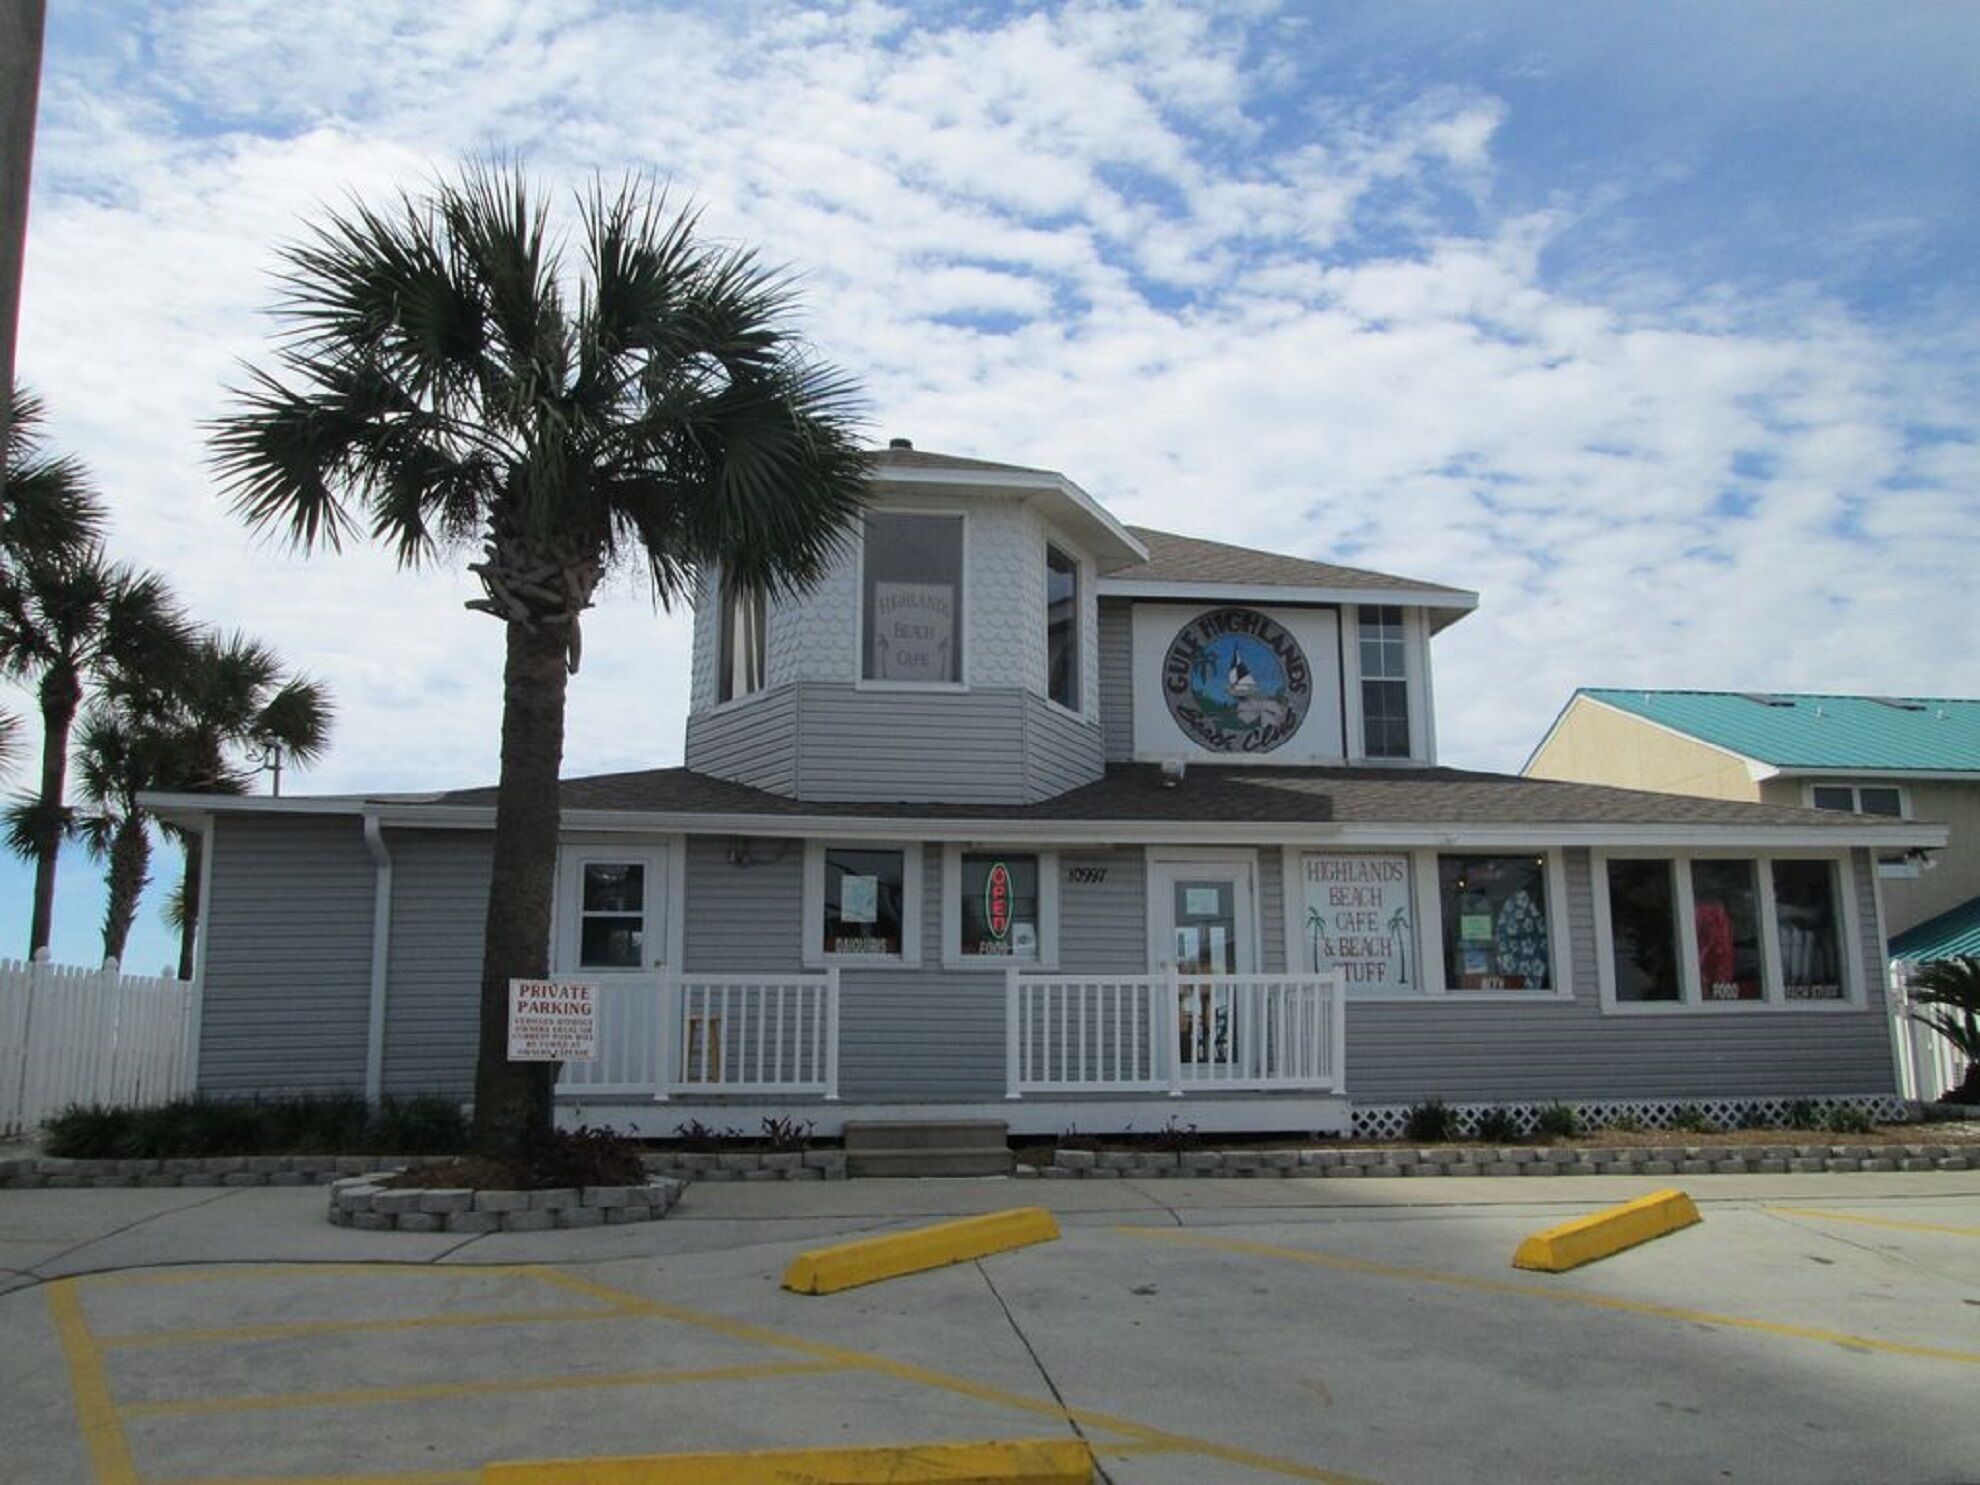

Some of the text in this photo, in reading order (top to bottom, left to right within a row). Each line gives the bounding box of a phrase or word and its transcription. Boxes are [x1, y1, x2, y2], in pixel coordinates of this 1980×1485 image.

[1167, 612, 1307, 696] GULF HIGHLANDS
[1243, 707, 1297, 751] Club
[1307, 860, 1404, 882] HIGHLANDS
[992, 867, 1006, 931] OPEN
[1329, 886, 1382, 907] BEACH
[1335, 912, 1379, 932] CAFE
[1323, 937, 1392, 957] & BEACH
[520, 984, 590, 1000] PRIVATE
[517, 1001, 592, 1015] PARKING
